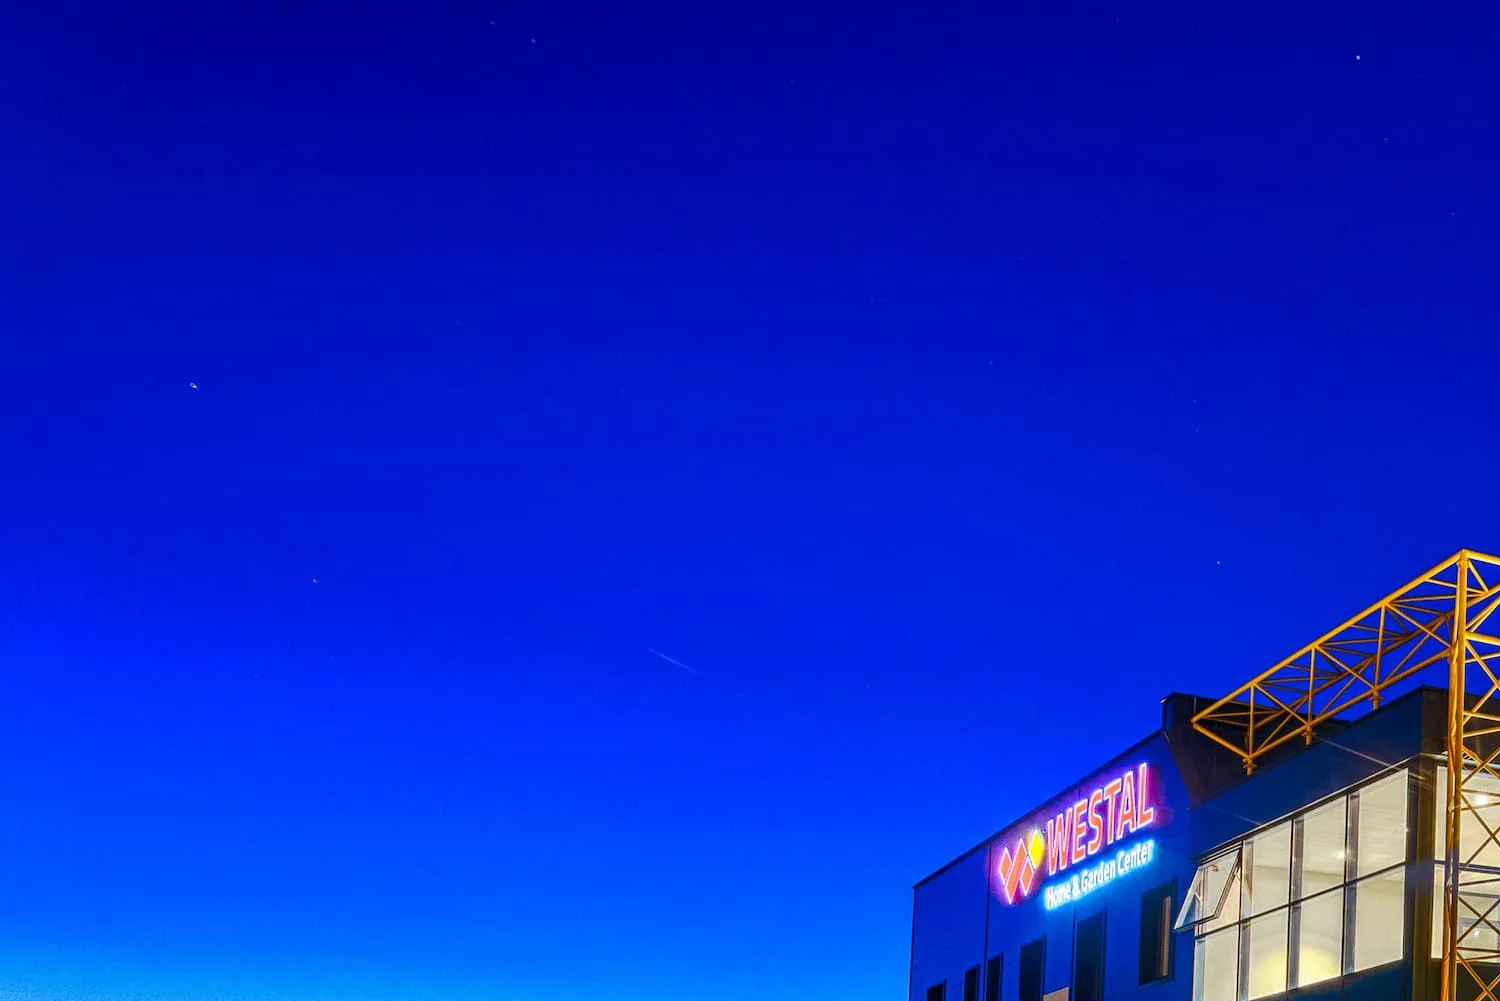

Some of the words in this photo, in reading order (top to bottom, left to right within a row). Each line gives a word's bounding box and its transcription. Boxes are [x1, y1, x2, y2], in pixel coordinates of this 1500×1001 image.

[1047, 762, 1154, 876] WESTAL
[1045, 884, 1071, 910] Home
[1071, 874, 1081, 899] &
[1081, 861, 1116, 893] Garden
[1117, 839, 1154, 875] Center
